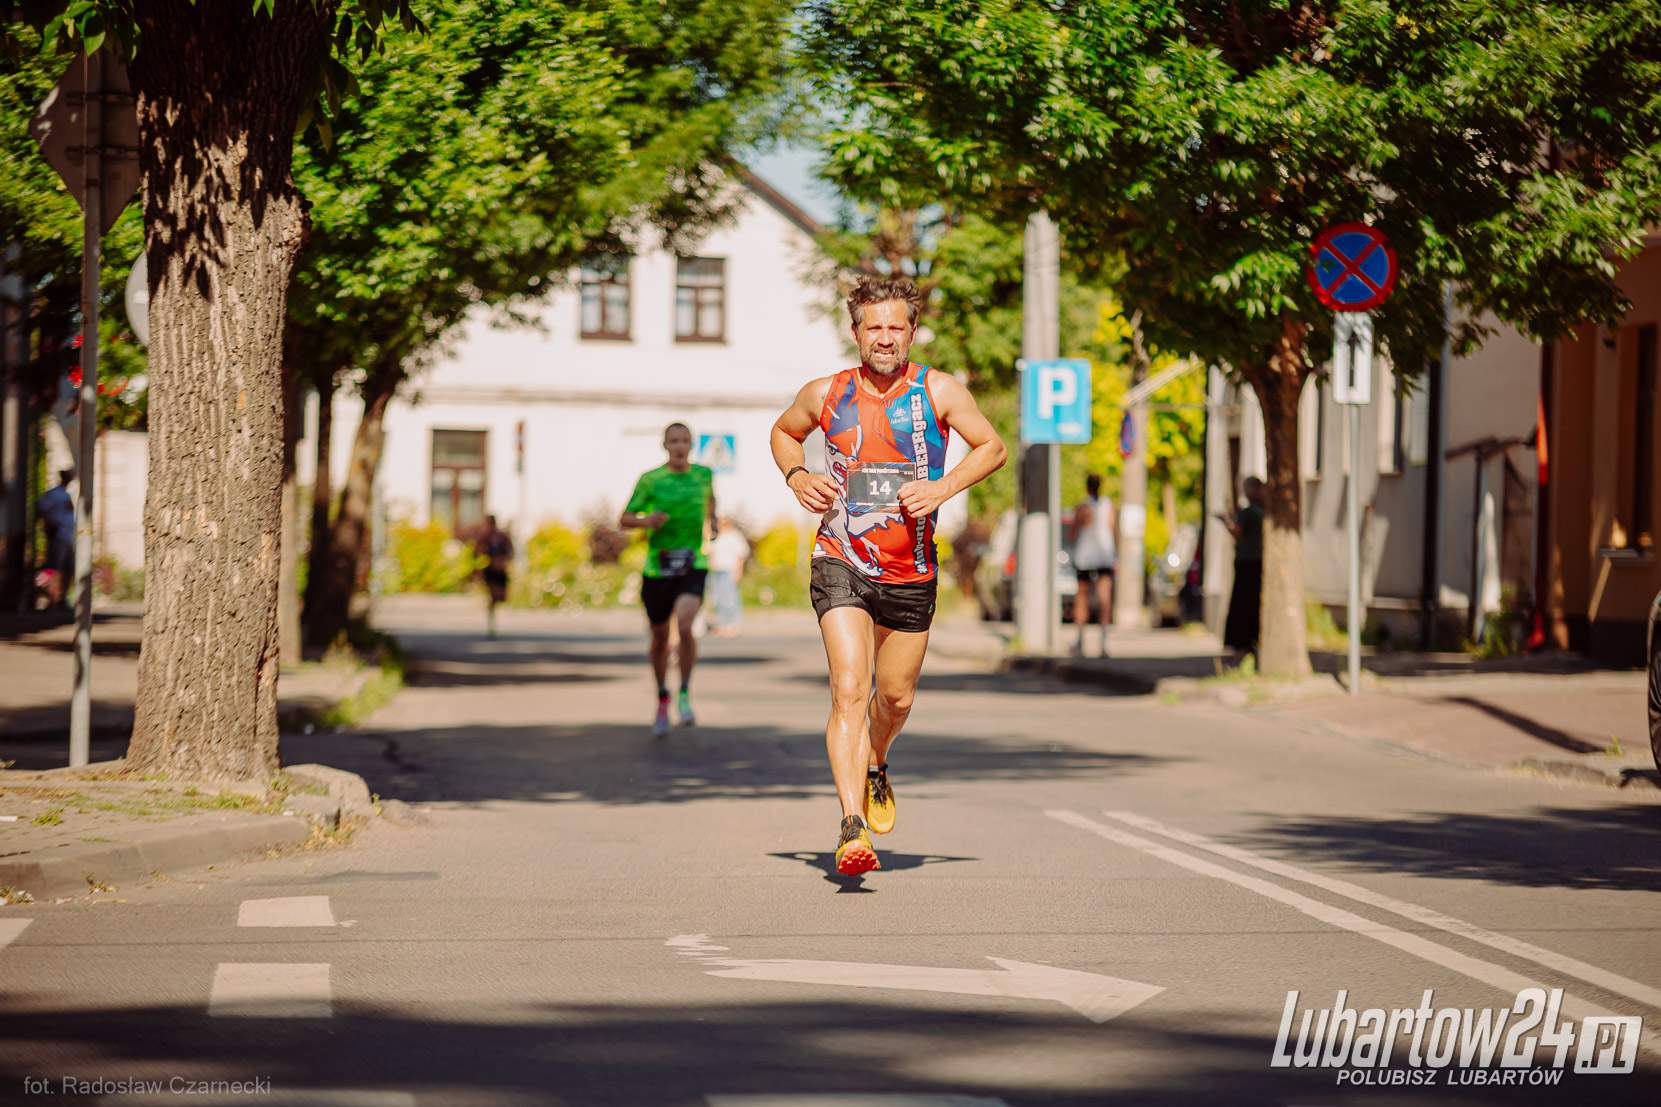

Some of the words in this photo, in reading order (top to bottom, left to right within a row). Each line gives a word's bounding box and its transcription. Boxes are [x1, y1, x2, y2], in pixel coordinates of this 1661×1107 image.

[1037, 367, 1077, 420] P
[910, 393, 928, 481] BEERgacz
[869, 480, 892, 496] 14
